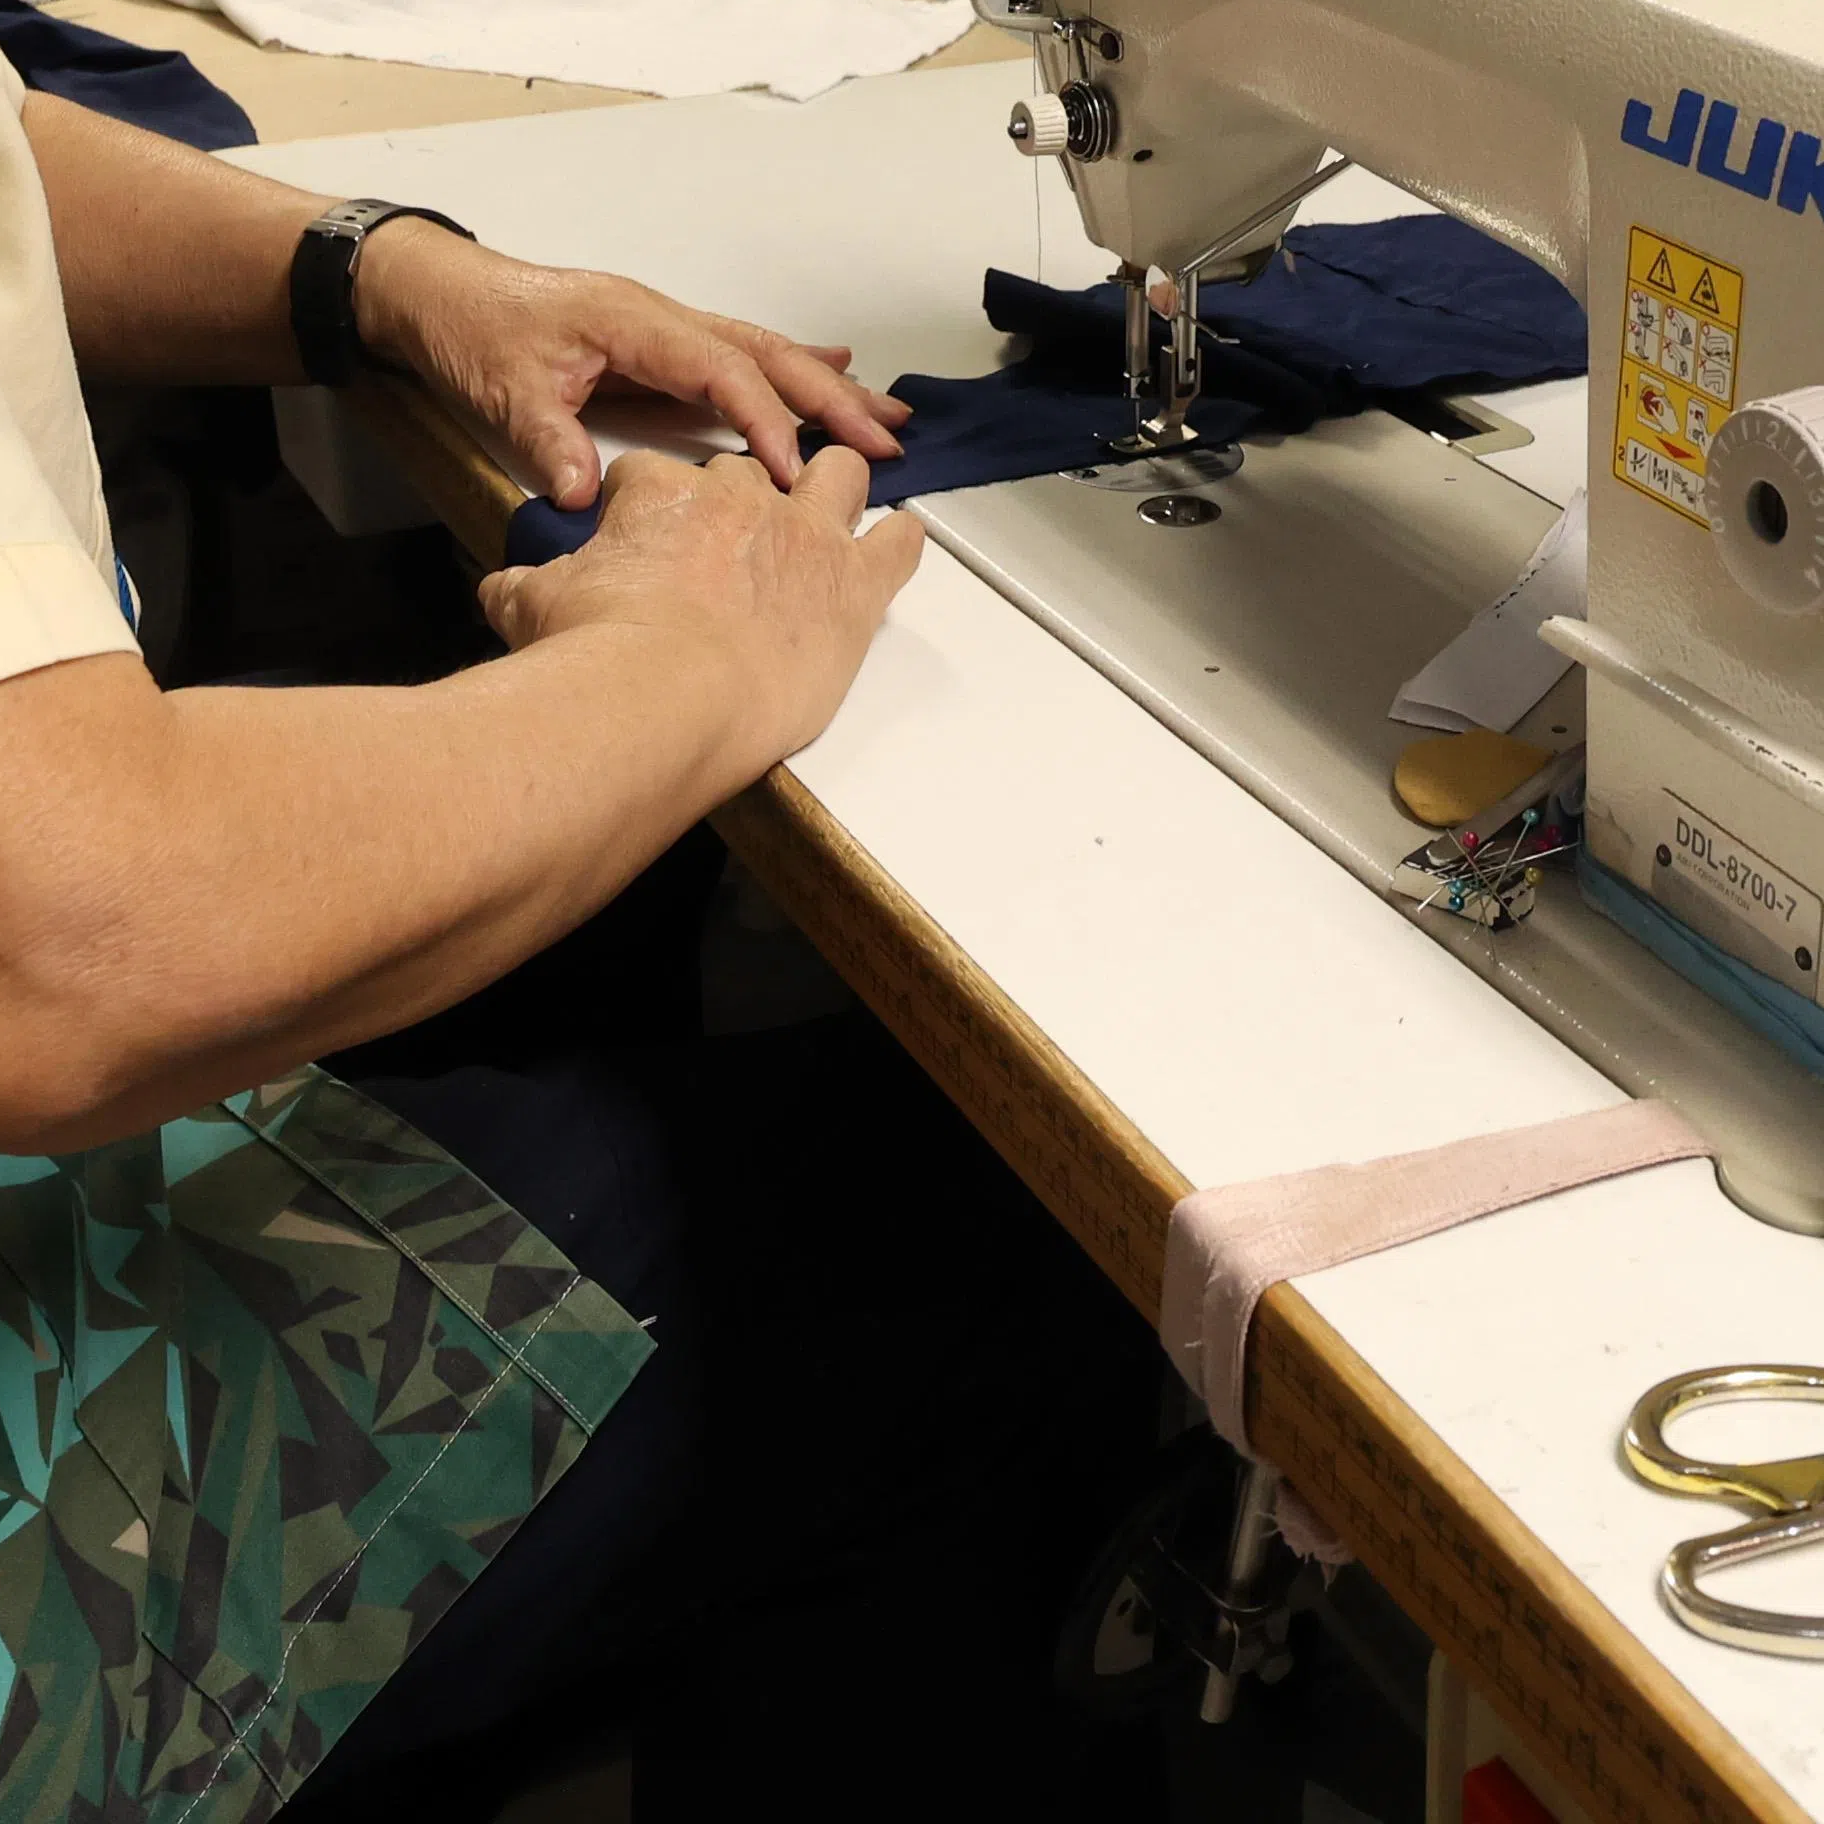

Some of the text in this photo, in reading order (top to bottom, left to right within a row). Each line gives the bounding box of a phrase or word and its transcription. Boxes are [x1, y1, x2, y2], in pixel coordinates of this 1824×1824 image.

[1764, 419, 1780, 443] 2
[1617, 445, 1626, 461] 2
[1676, 816, 1797, 923] DDL-8700-7
